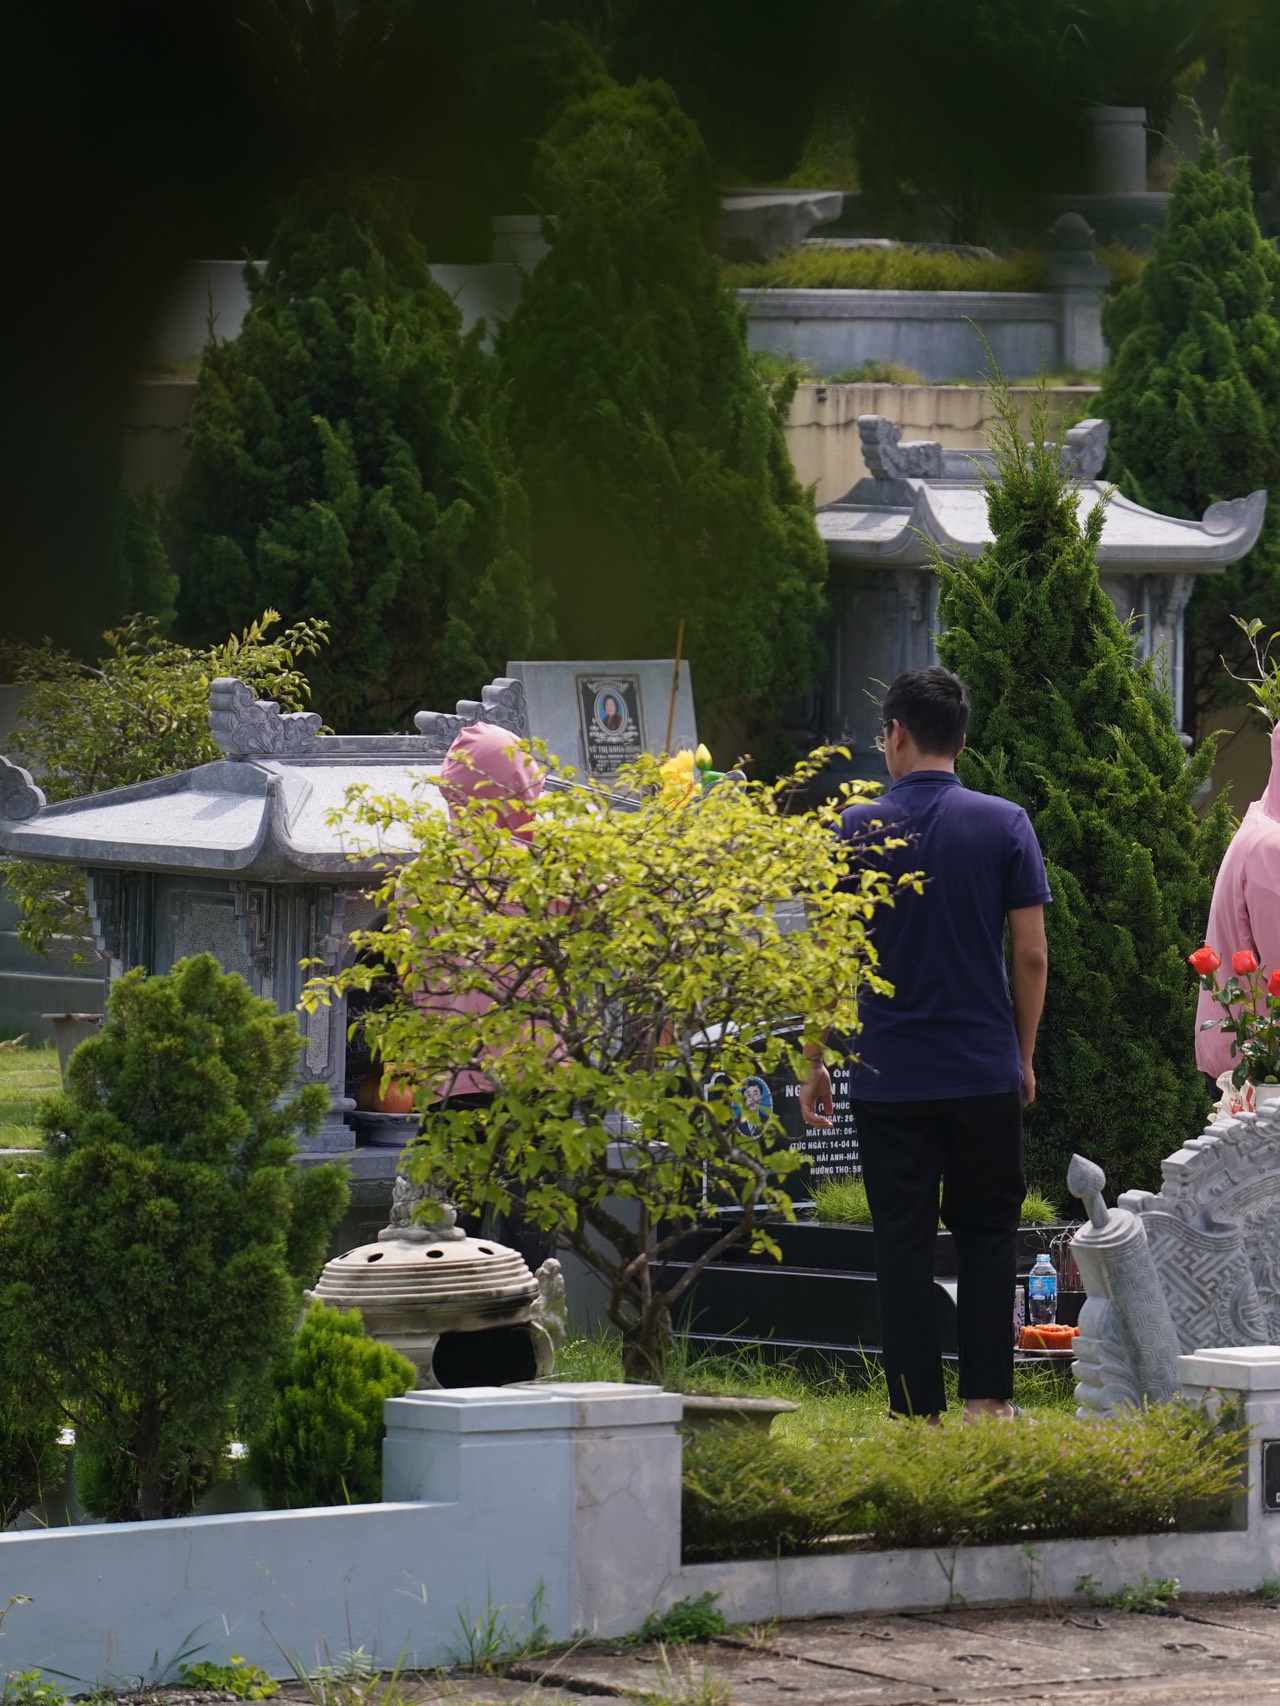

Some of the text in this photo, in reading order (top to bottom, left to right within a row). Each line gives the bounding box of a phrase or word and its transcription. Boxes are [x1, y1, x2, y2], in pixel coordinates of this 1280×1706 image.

[833, 1069, 850, 1078] ÔN
[822, 1127, 843, 1136] NGÀY:
[844, 1127, 858, 1135] 06-
[808, 1141, 828, 1149] NGÀY:
[829, 1140, 850, 1148] 14-04
